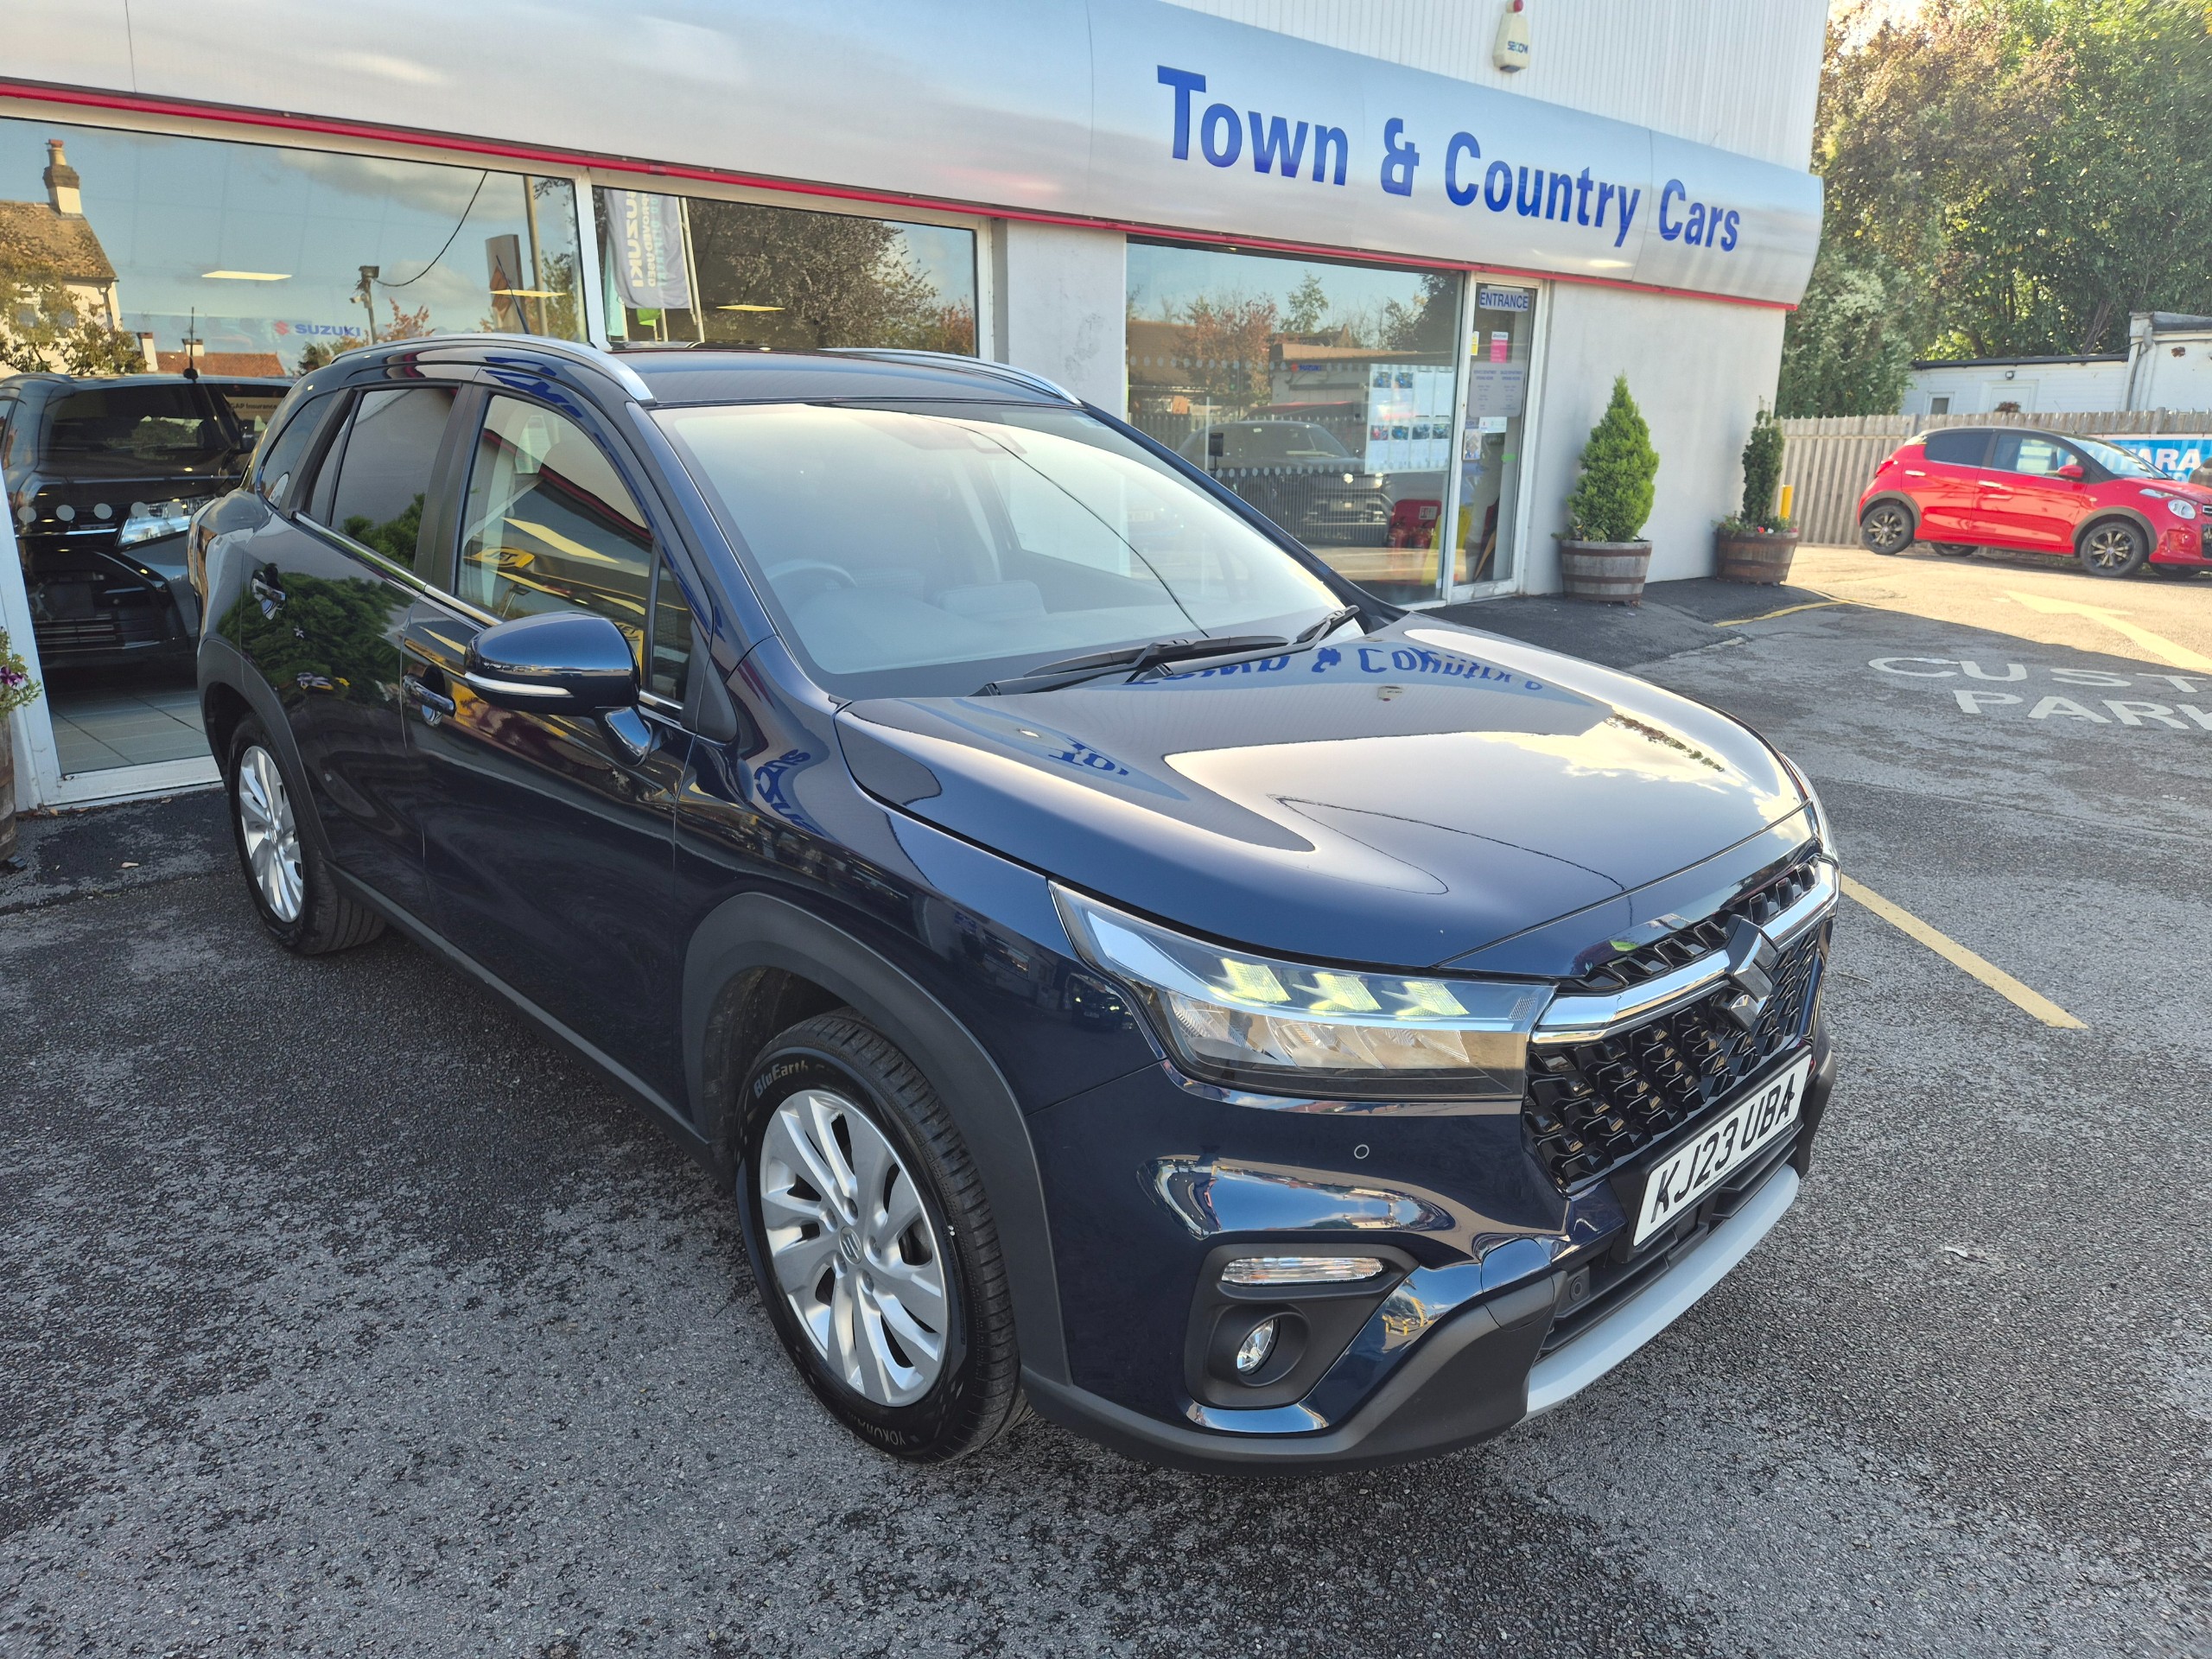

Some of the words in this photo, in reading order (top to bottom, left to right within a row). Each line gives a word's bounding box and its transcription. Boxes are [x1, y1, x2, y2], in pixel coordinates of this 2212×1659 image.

[1157, 65, 1348, 186] Town
[1381, 118, 1420, 197] &
[1445, 131, 1641, 248] Country
[1659, 178, 1740, 252] Cars
[1479, 292, 1529, 309] ENTRANCE
[295, 324, 361, 337] SUZUKI
[1868, 657, 2208, 693] CUST
[753, 1059, 809, 1099] BluEarth
[1650, 1117, 1739, 1224] KJ23
[1741, 1073, 1796, 1151] UBA
